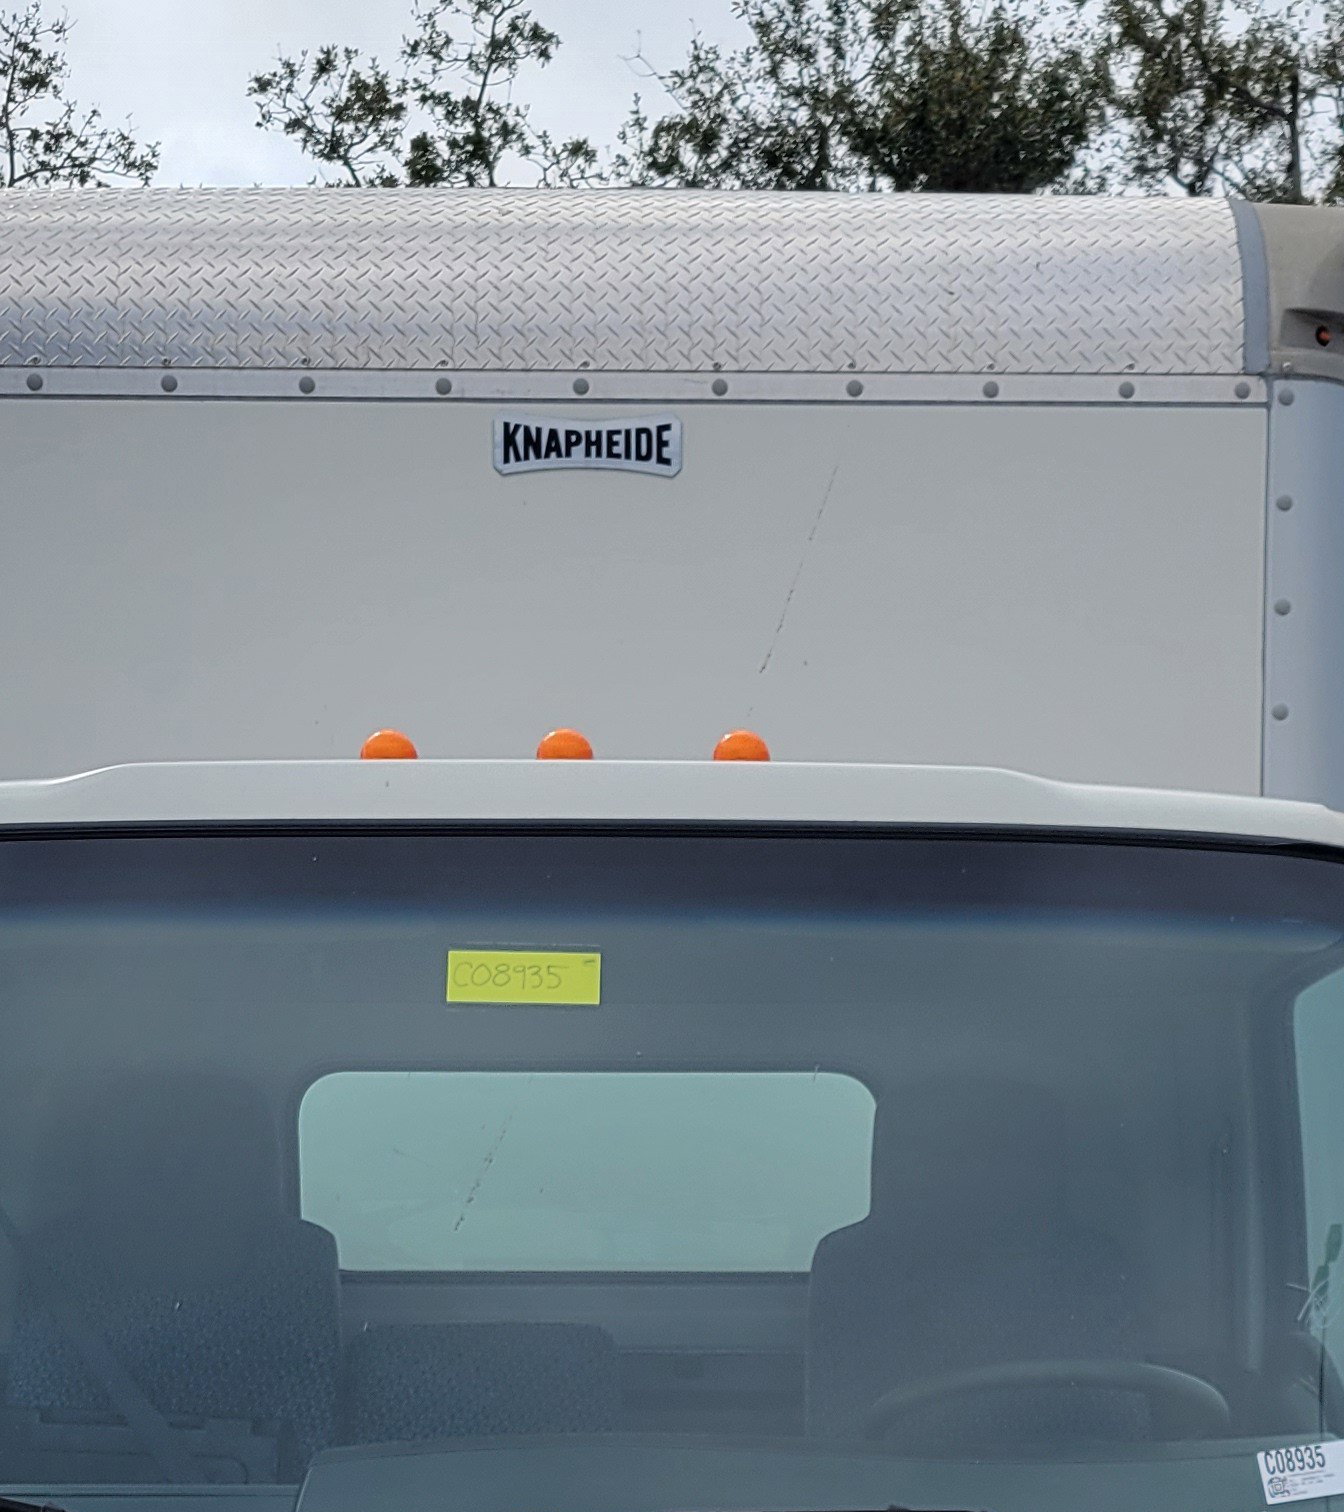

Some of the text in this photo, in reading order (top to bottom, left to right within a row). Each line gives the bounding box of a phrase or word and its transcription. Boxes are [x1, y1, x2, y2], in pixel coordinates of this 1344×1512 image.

[502, 420, 673, 467] KNAPHEIDE
[452, 961, 569, 990] C08935
[1264, 1445, 1326, 1475] C08935
